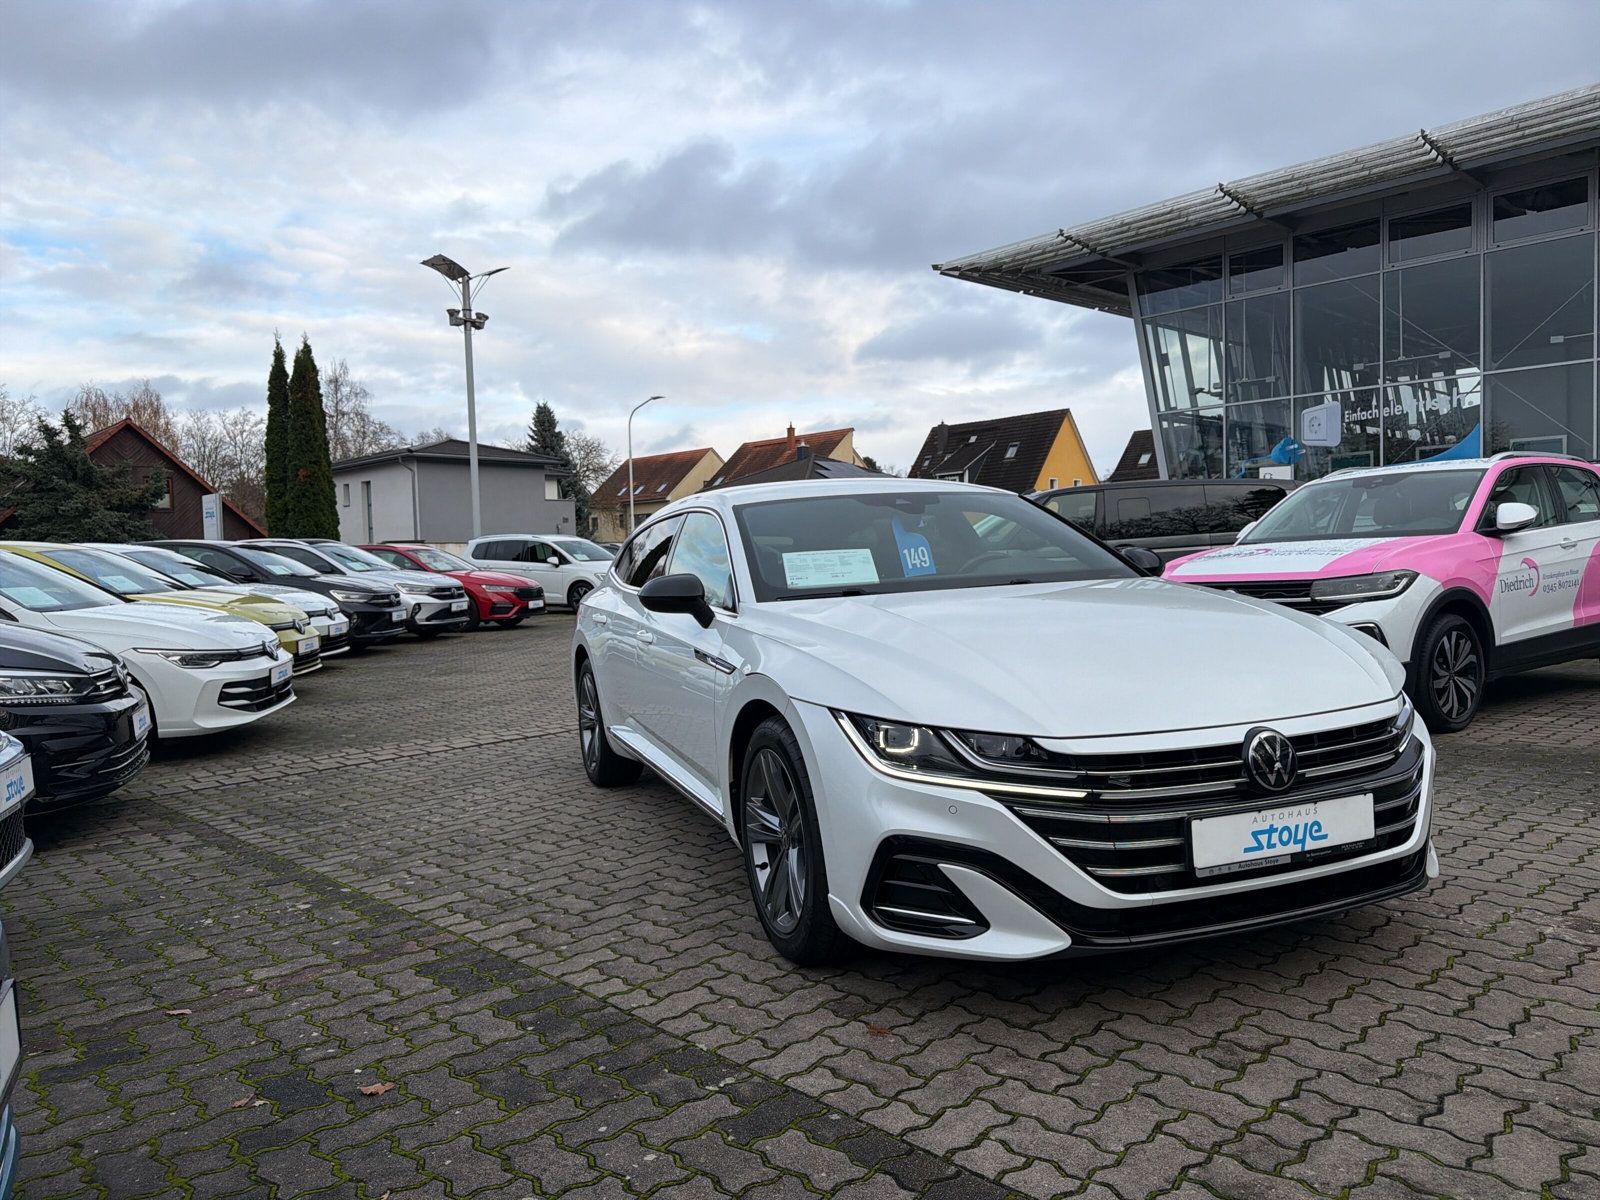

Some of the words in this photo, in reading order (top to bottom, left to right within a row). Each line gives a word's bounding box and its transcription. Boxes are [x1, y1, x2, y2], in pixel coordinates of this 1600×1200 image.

[1344, 407, 1379, 422] Einfach
[902, 546, 930, 569] 149
[1500, 573, 1534, 593] Diedrich
[1543, 582, 1557, 593] 0345
[1252, 806, 1318, 824] AUTOHAUS
[1238, 860, 1263, 869] Autohaus
[1264, 857, 1279, 866] Stoye
